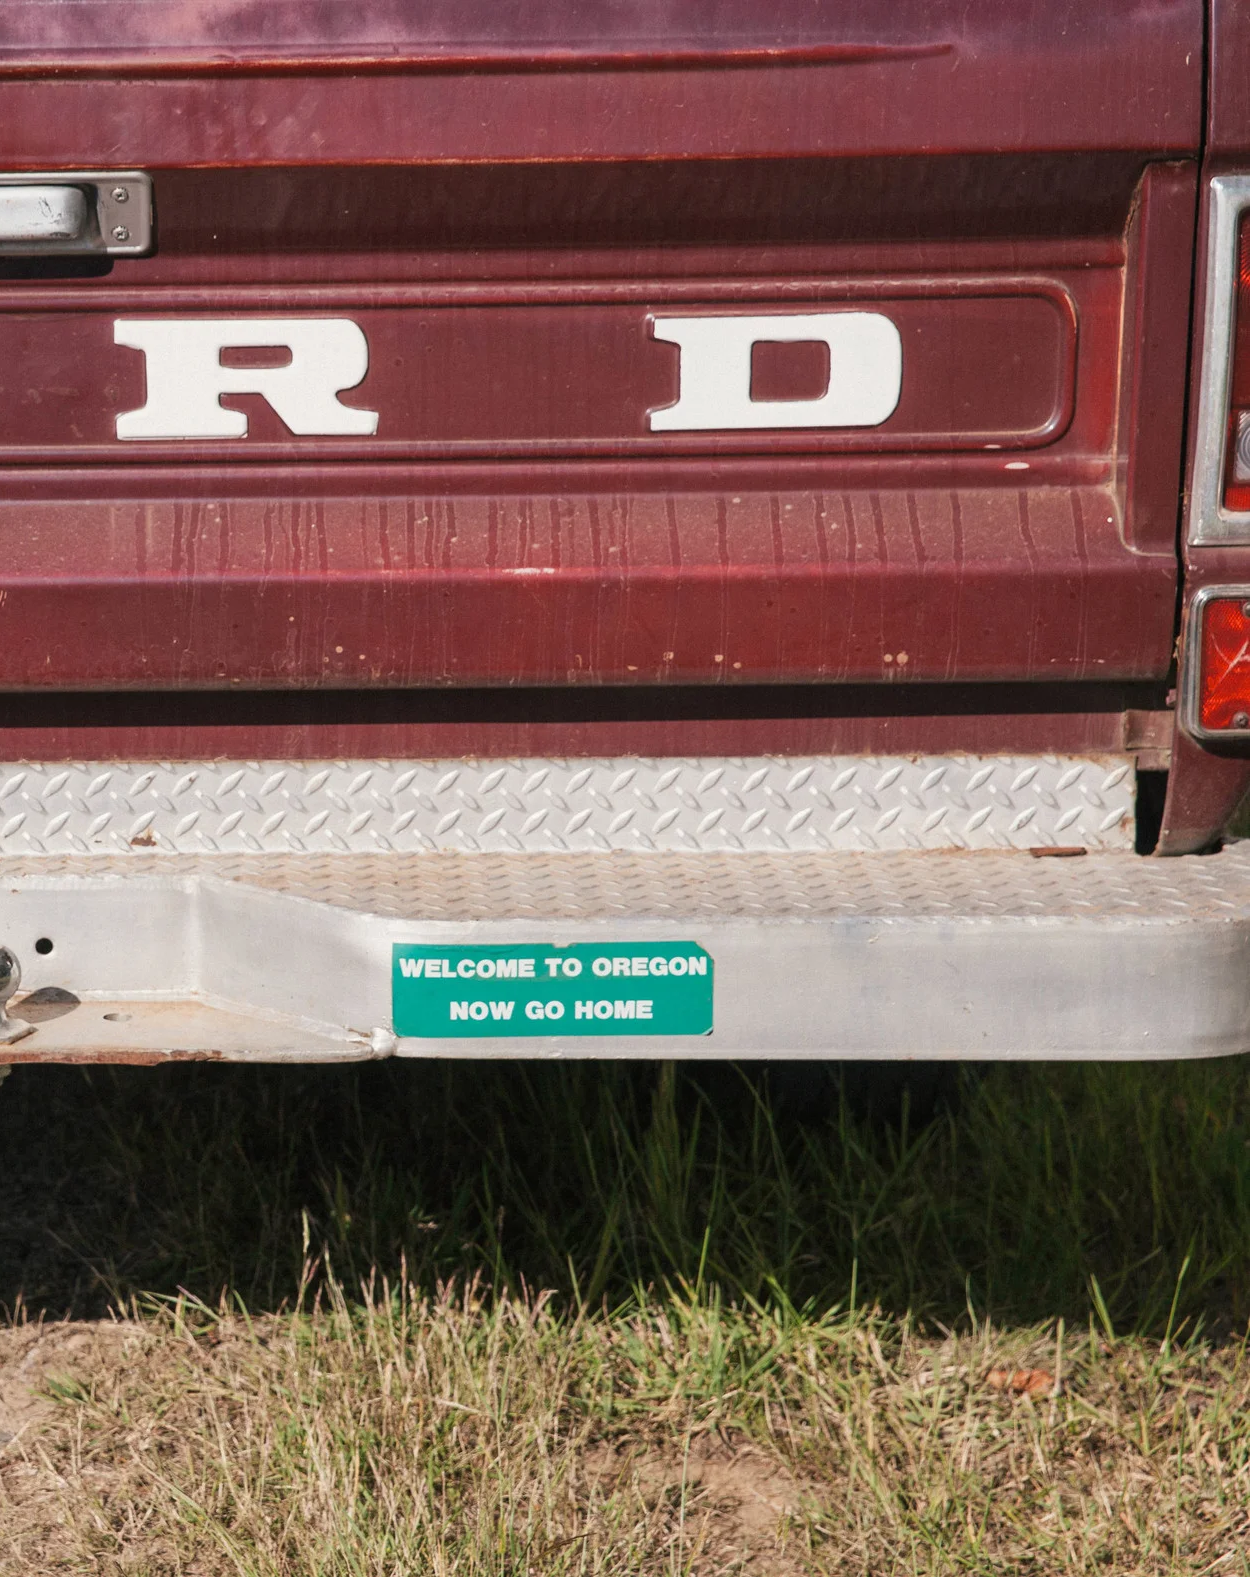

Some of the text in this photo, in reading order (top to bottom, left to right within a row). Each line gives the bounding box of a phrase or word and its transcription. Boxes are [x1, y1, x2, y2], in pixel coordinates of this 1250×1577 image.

[399, 956, 708, 978] WELCOME TO OREGON
[450, 1000, 654, 1020] NOW GO HOME
